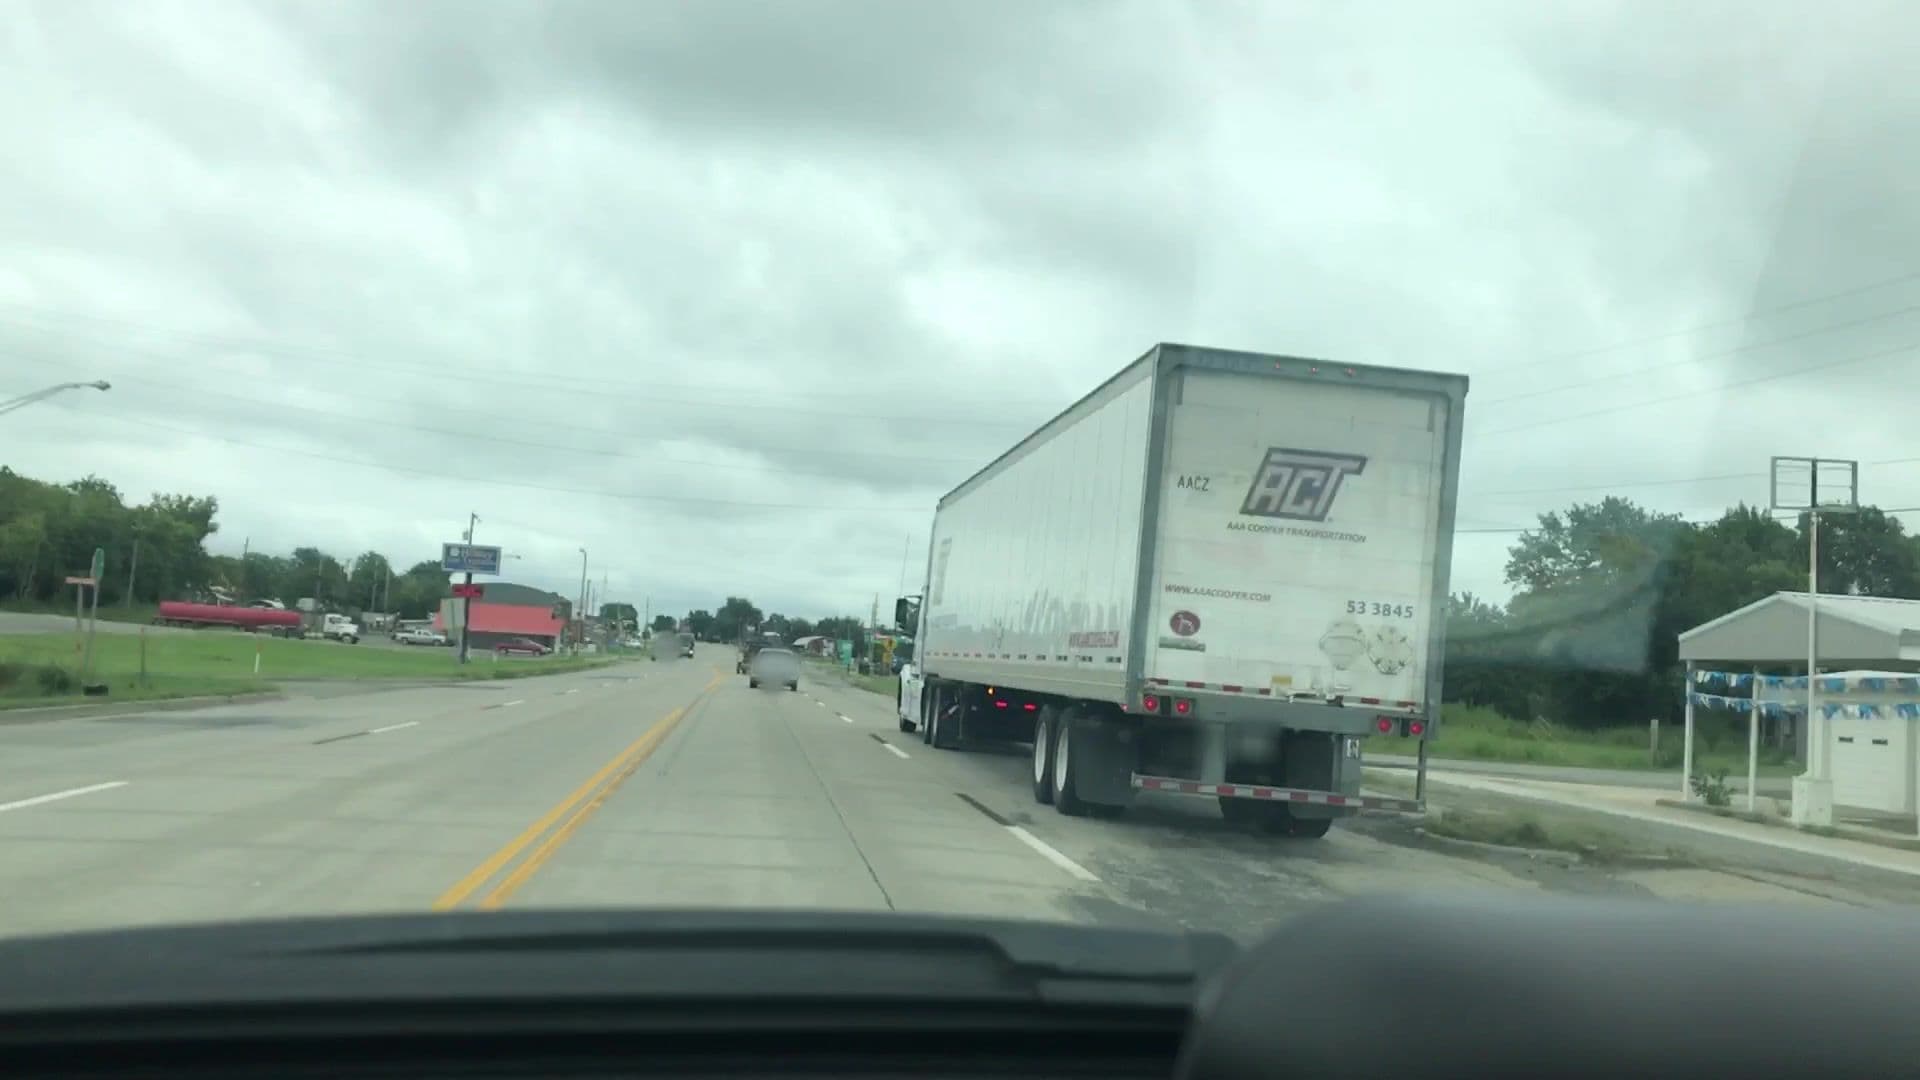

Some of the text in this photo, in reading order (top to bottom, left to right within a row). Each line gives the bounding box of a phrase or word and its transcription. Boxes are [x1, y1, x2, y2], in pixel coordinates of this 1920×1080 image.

[1177, 475, 1210, 492] AACZ
[1239, 447, 1368, 522] ACT
[1227, 521, 1367, 543] AAA COOPER TRANSPORTATION
[1347, 600, 1413, 619] 53 3845
